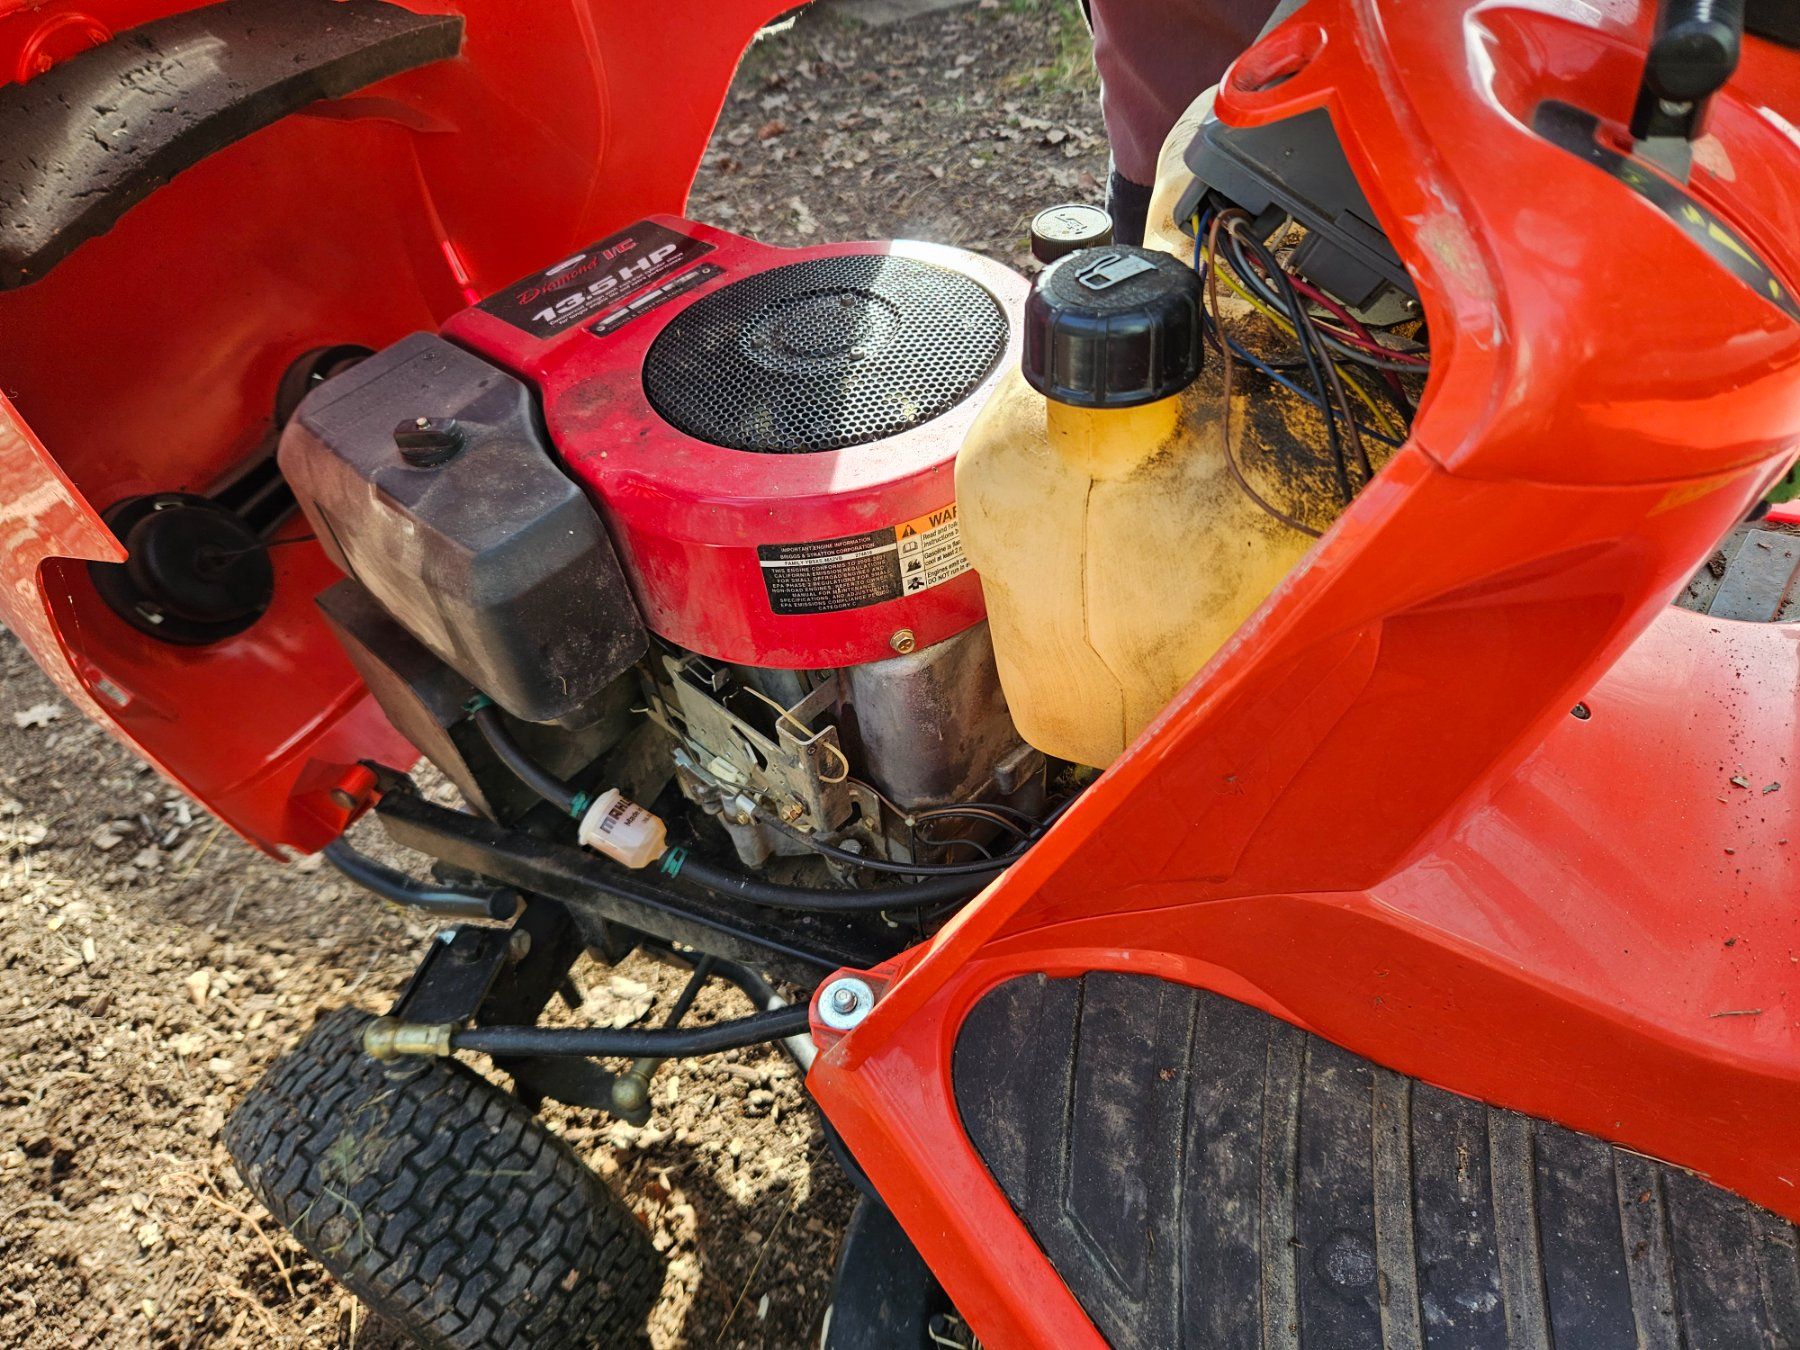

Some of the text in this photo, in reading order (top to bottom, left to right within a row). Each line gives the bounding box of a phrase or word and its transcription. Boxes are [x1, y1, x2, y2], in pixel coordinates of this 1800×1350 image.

[531, 275, 618, 322] 13.5
[619, 244, 677, 281] HP
[923, 531, 936, 540] Read
[938, 526, 948, 534] and
[833, 536, 870, 547] INFORMATION
[835, 542, 874, 554] CORPORATION
[924, 546, 947, 559] Gasoline
[942, 551, 954, 559] least
[811, 562, 845, 570] CONFORMS
[842, 559, 885, 572] REGULATIONS
[843, 568, 870, 577] ENGINES
[927, 566, 948, 579] Engines
[938, 572, 950, 580] NOT
[812, 576, 855, 586] REGULATIONS
[832, 582, 876, 594] MAINTENANCE
[827, 594, 867, 604] COMPLIANCE
[818, 602, 851, 610] CATEGORY
